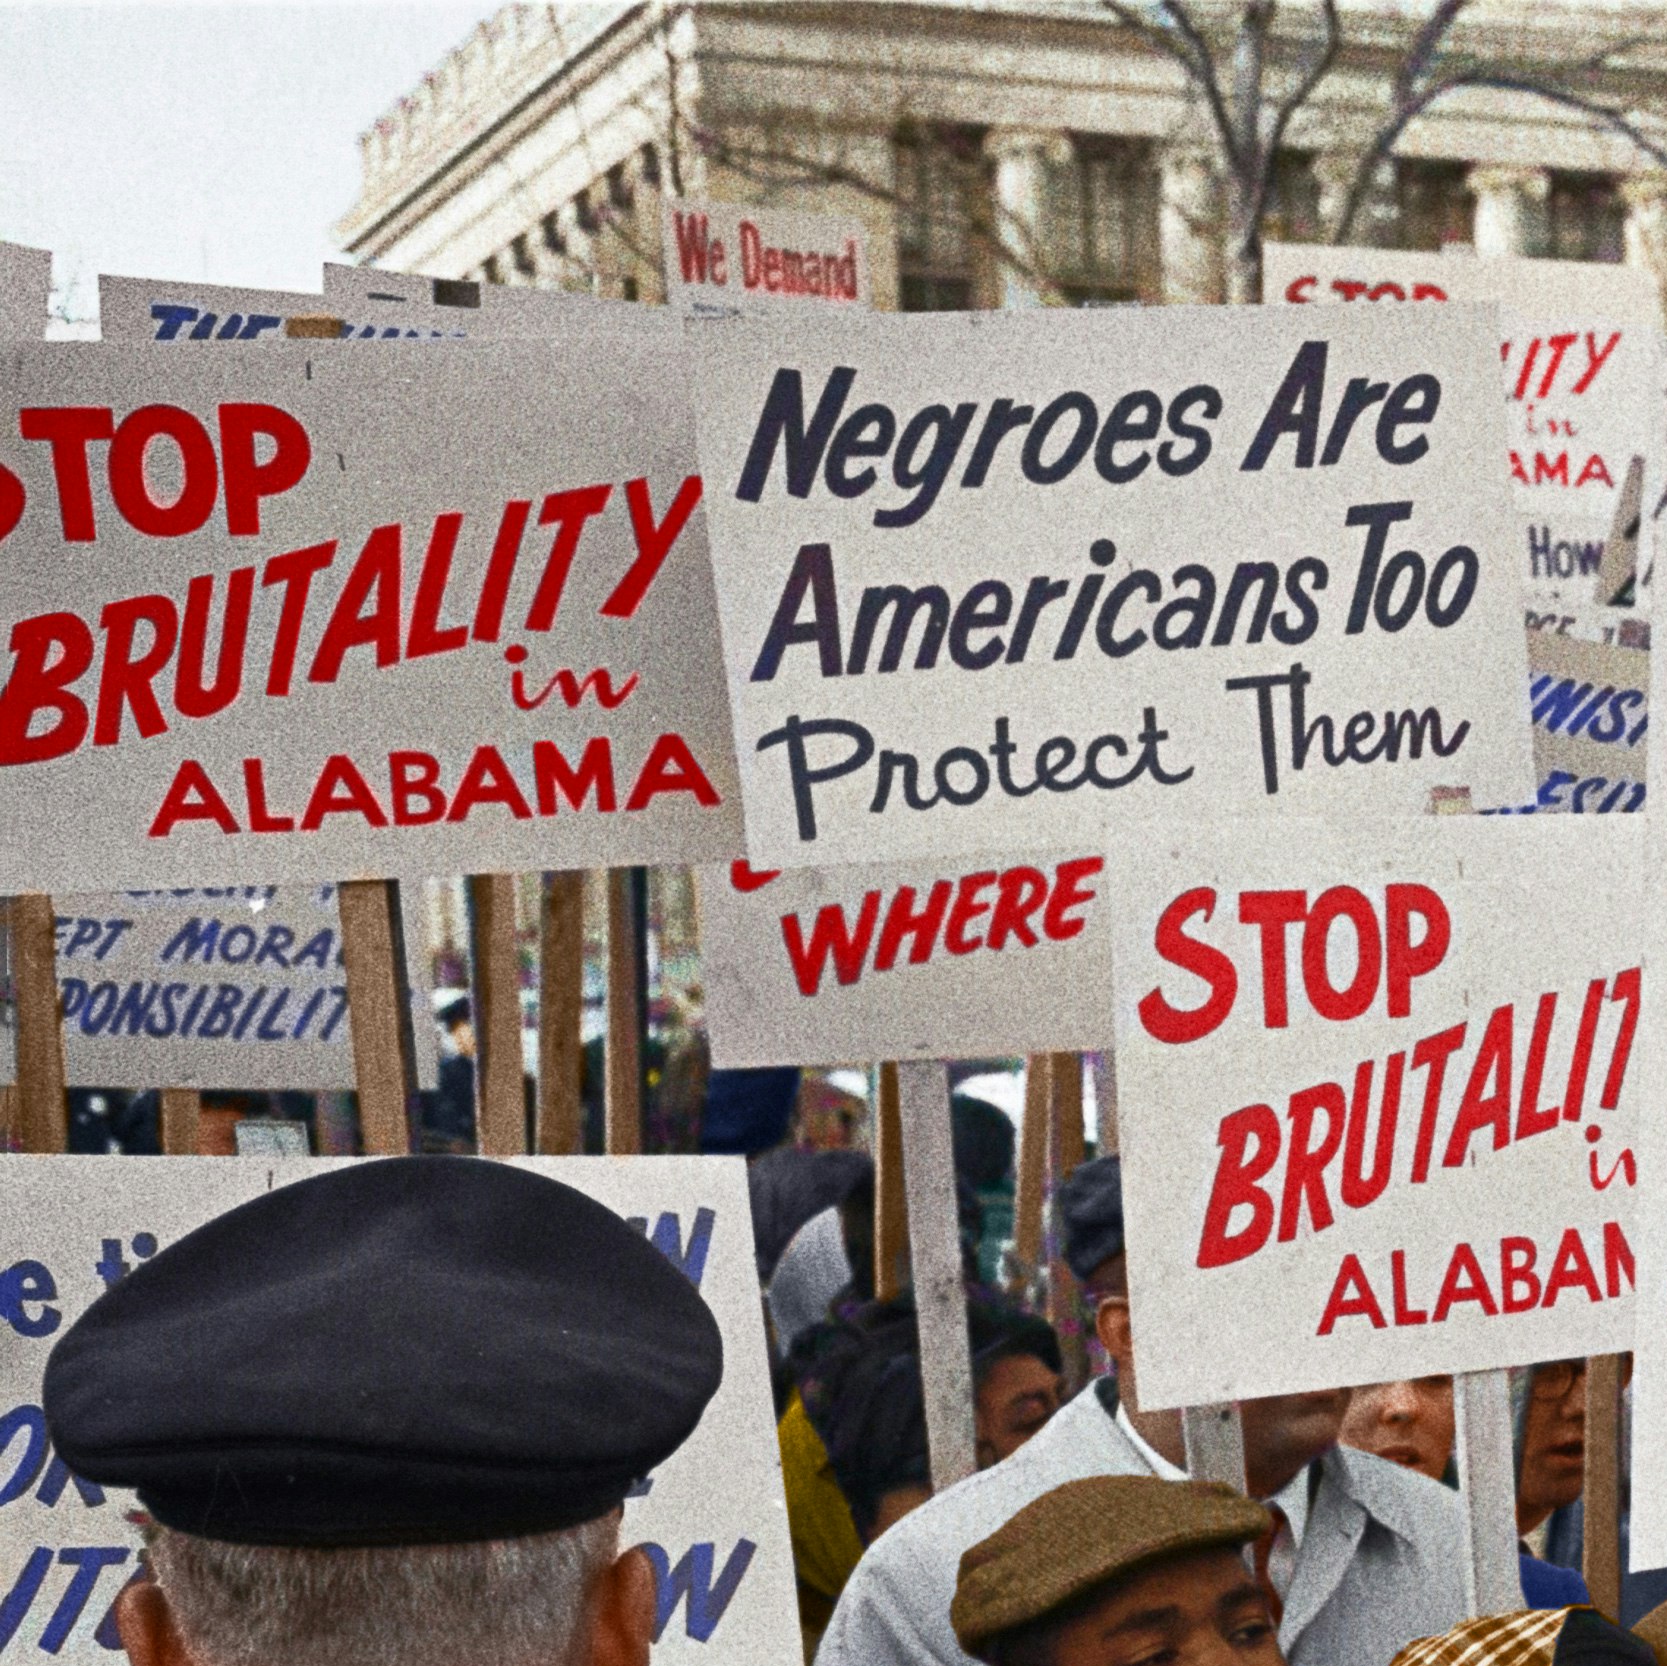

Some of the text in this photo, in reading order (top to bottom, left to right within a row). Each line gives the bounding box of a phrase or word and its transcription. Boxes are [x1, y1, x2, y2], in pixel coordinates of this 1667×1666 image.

[673, 210, 858, 301] We Demand
[735, 340, 1442, 529] Negroes Are
[1500, 331, 1622, 400] ITY
[0, 402, 311, 543] TOP
[0, 474, 703, 766] BRUTALITY
[750, 501, 1480, 682] Americans Too
[503, 644, 640, 710] in
[148, 733, 722, 838] ALABAMA
[756, 663, 1471, 841] Protect Them
[160, 917, 345, 969] MORA
[780, 856, 1105, 998] WHERE
[1137, 883, 1452, 1045] STOP
